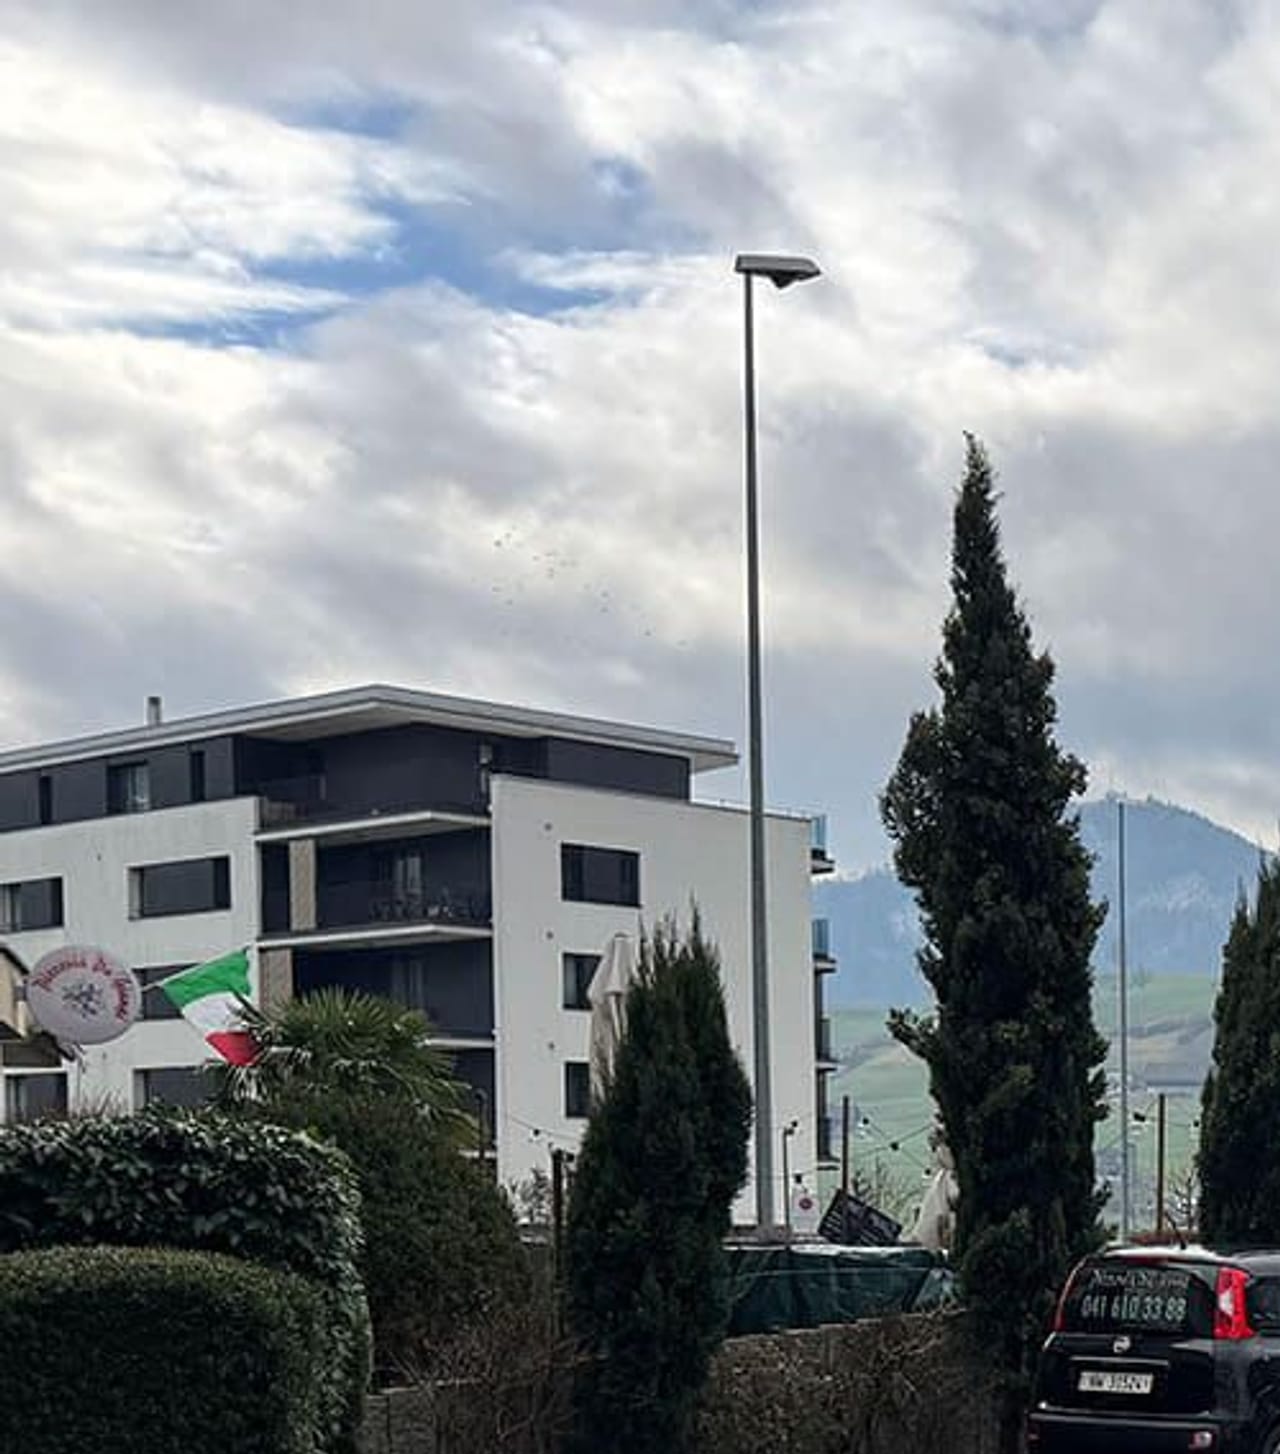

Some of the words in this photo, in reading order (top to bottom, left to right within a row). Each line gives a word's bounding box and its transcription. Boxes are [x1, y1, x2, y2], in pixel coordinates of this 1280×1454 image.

[1111, 1296, 1140, 1320] 610
[1142, 1297, 1163, 1320] 33
[1165, 1296, 1187, 1322] 88
